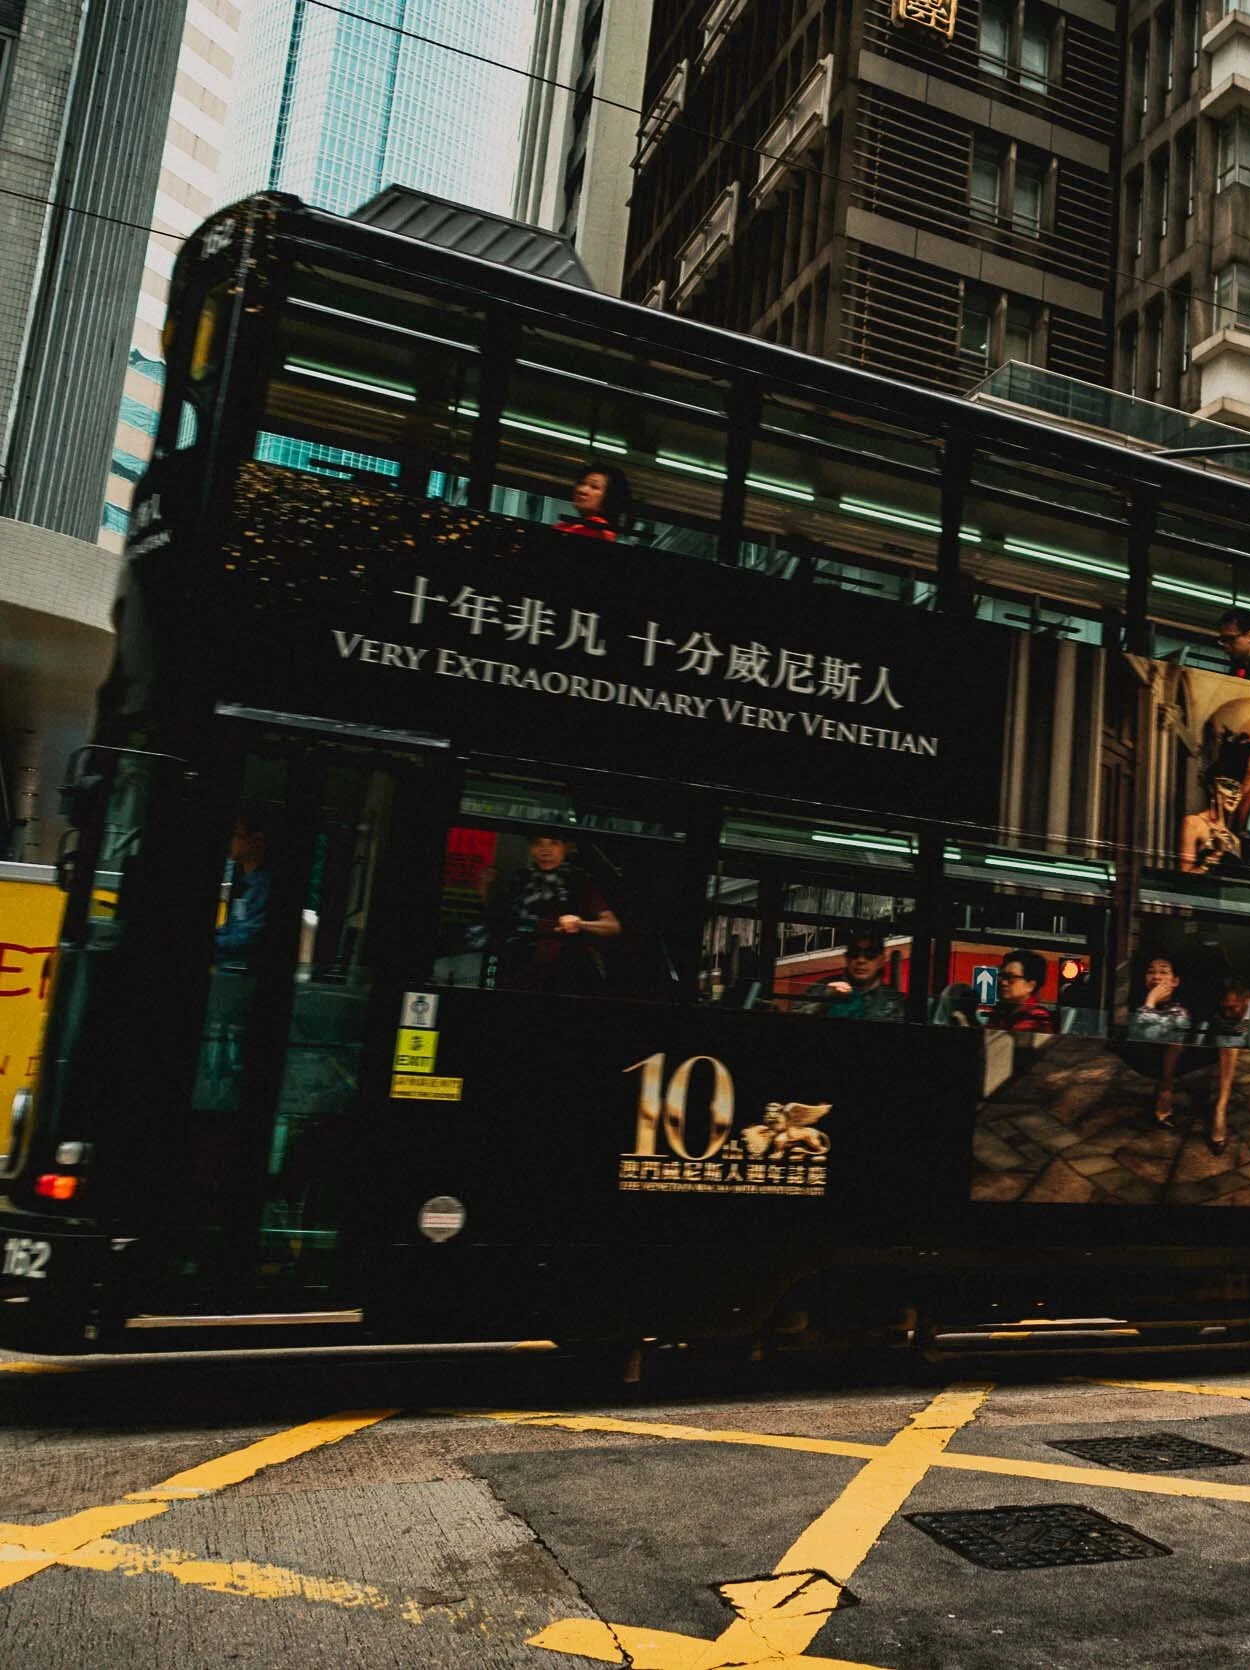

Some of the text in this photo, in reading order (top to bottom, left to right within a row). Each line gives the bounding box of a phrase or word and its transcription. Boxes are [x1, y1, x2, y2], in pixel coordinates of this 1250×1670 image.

[330, 629, 939, 757] VERY EXTRAORDINARY VERY VENETIAN
[393, 576, 904, 710] 十年非凡 十分威尼斯人
[1, 1238, 52, 1278] 162
